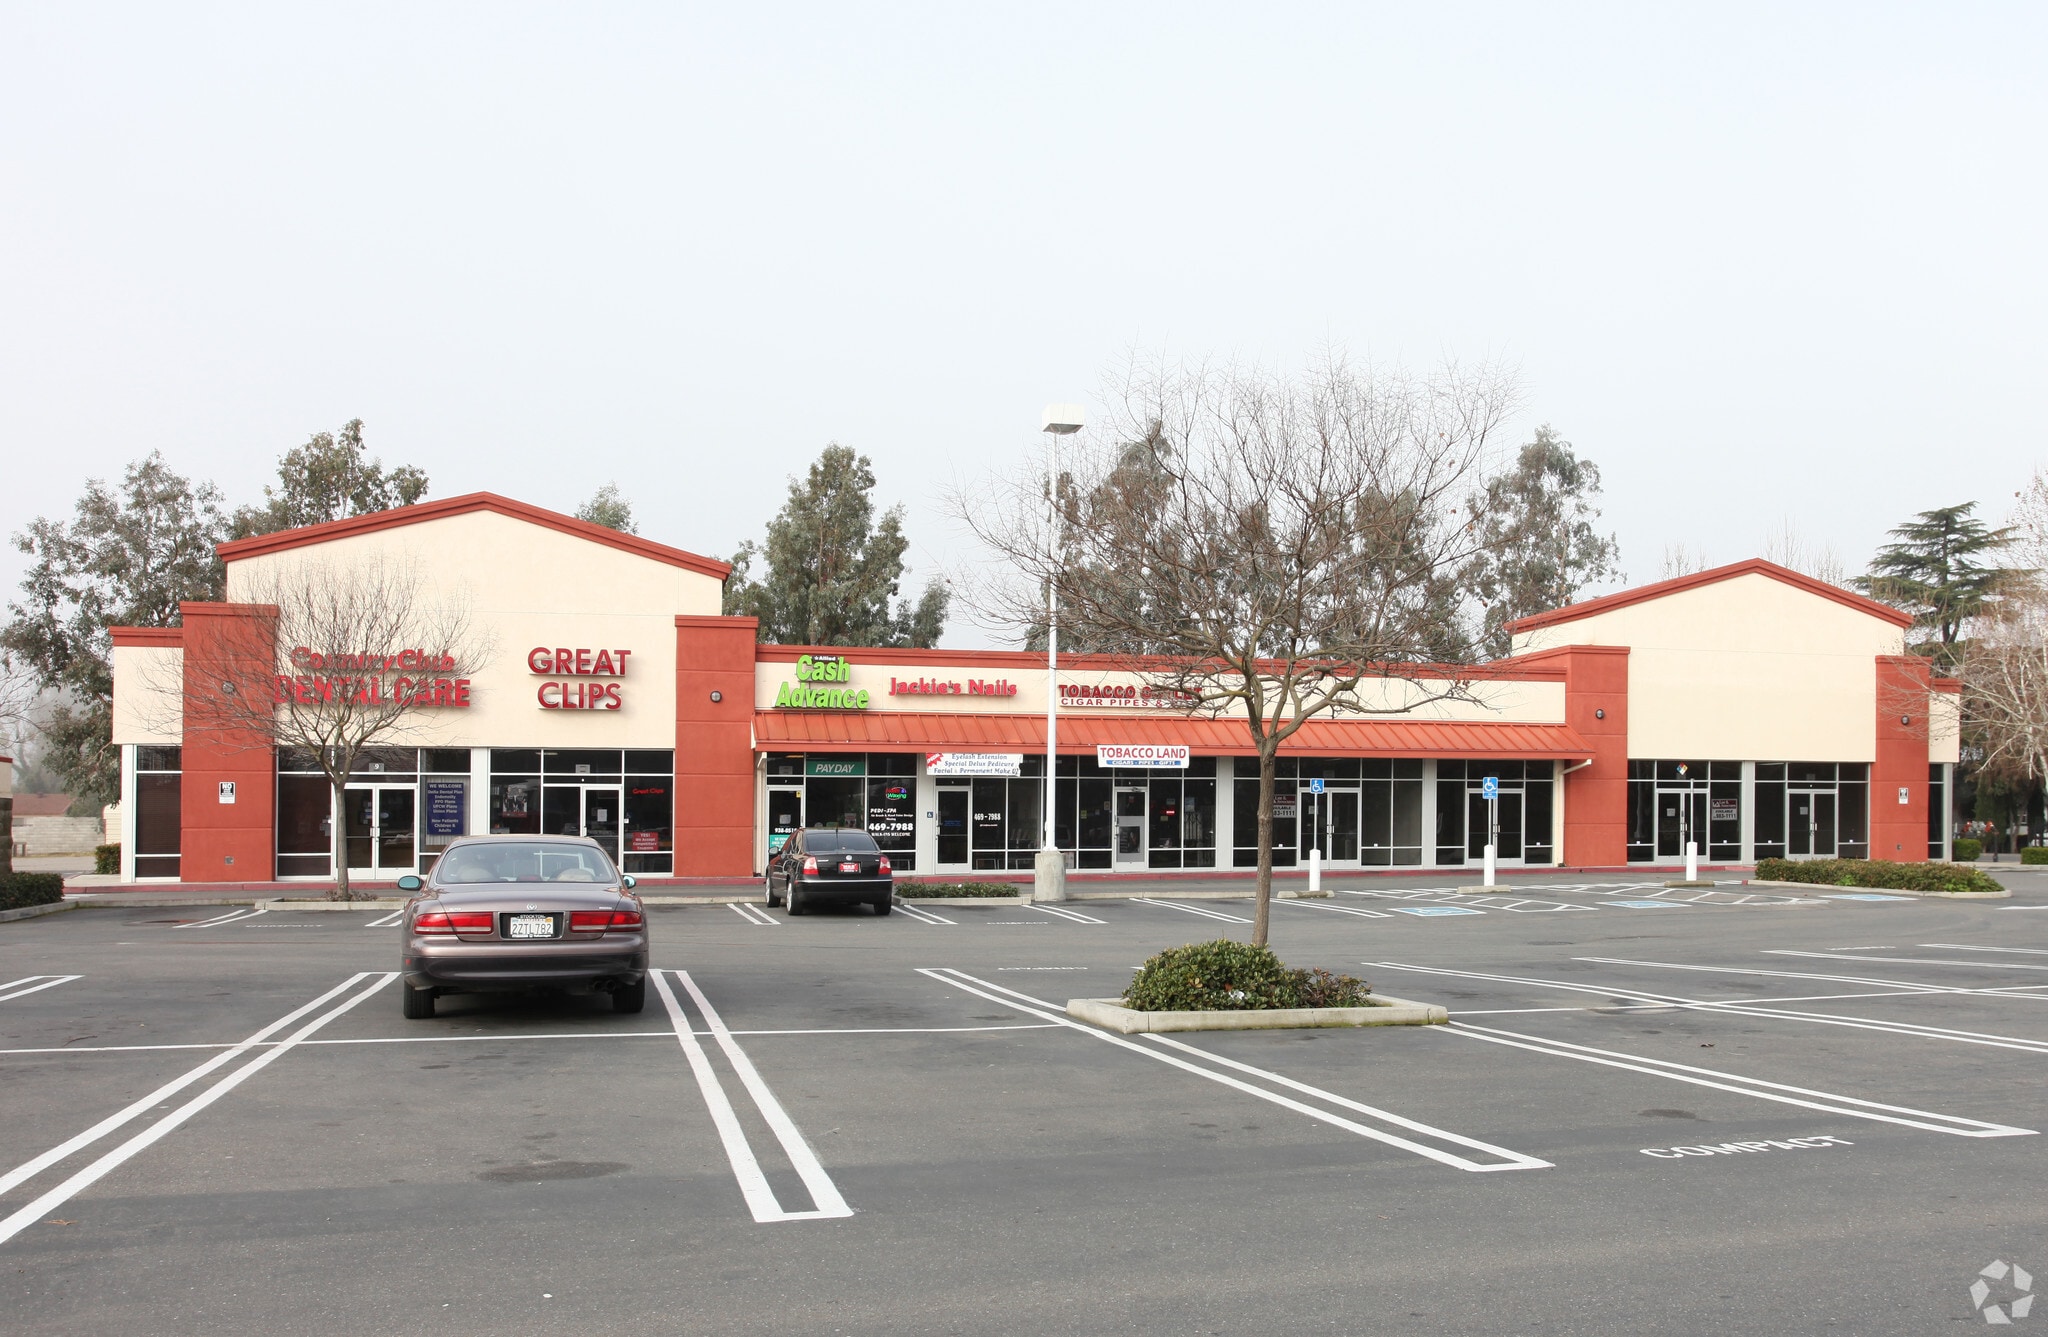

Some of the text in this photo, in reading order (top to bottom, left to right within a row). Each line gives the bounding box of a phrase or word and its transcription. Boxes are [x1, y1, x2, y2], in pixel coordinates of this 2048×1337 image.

[397, 648, 455, 671] Club
[528, 647, 632, 675] GREAT
[796, 654, 850, 681] Cash
[274, 675, 470, 706] DENTAL CARE
[538, 682, 622, 710] CLIPS
[775, 682, 870, 708] Advance
[888, 677, 1017, 696] Jackie's Nails
[1059, 684, 1136, 698] TOBACCO
[1100, 748, 1186, 759] TOBACCO LAND
[512, 924, 551, 935] 2ZTL782
[1640, 1136, 1854, 1158] COMPACT
